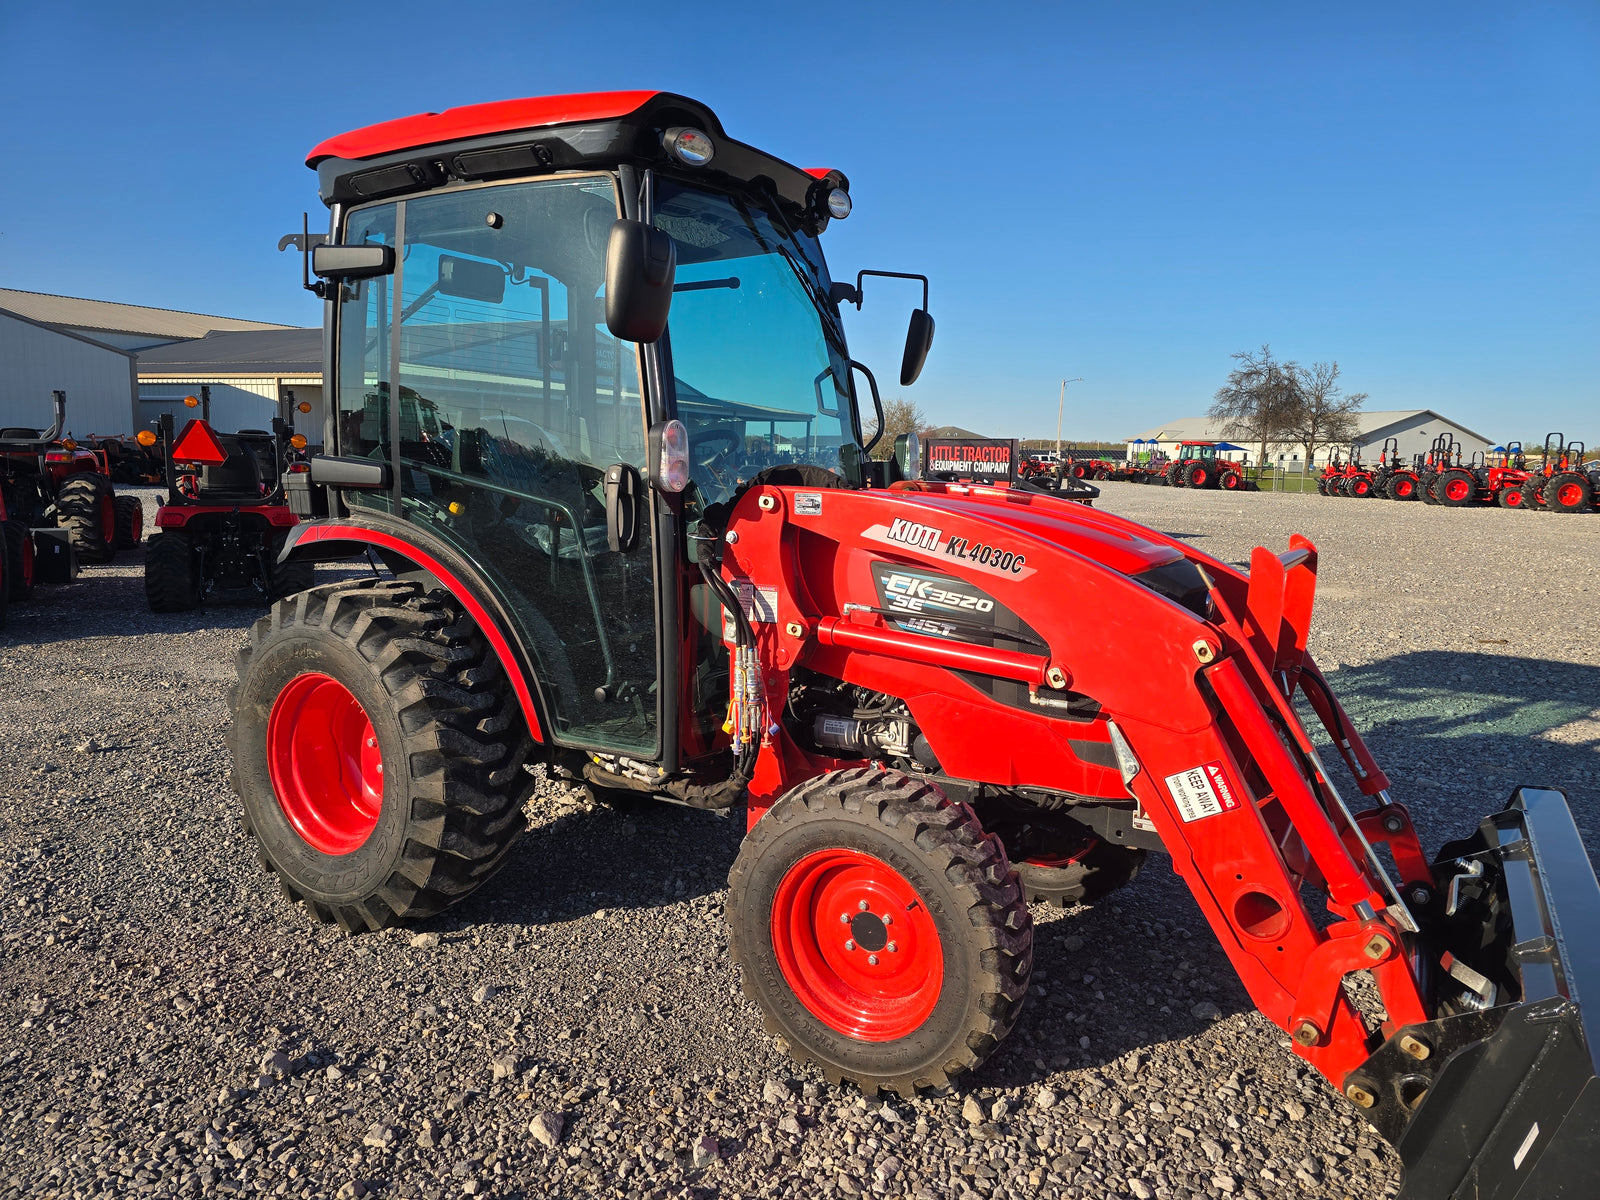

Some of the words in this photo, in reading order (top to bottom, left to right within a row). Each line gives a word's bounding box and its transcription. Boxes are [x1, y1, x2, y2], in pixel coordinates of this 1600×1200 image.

[929, 446, 961, 461] LITTLE
[962, 446, 1010, 463] TRACTOR
[973, 461, 1010, 474] COMPANY
[887, 517, 943, 551] KIOTI
[945, 536, 1026, 574] KL4030C
[892, 594, 925, 611] SE
[1186, 770, 1205, 789] KEEP
[1213, 774, 1235, 808] WARNING
[1195, 792, 1216, 813] AWAY
